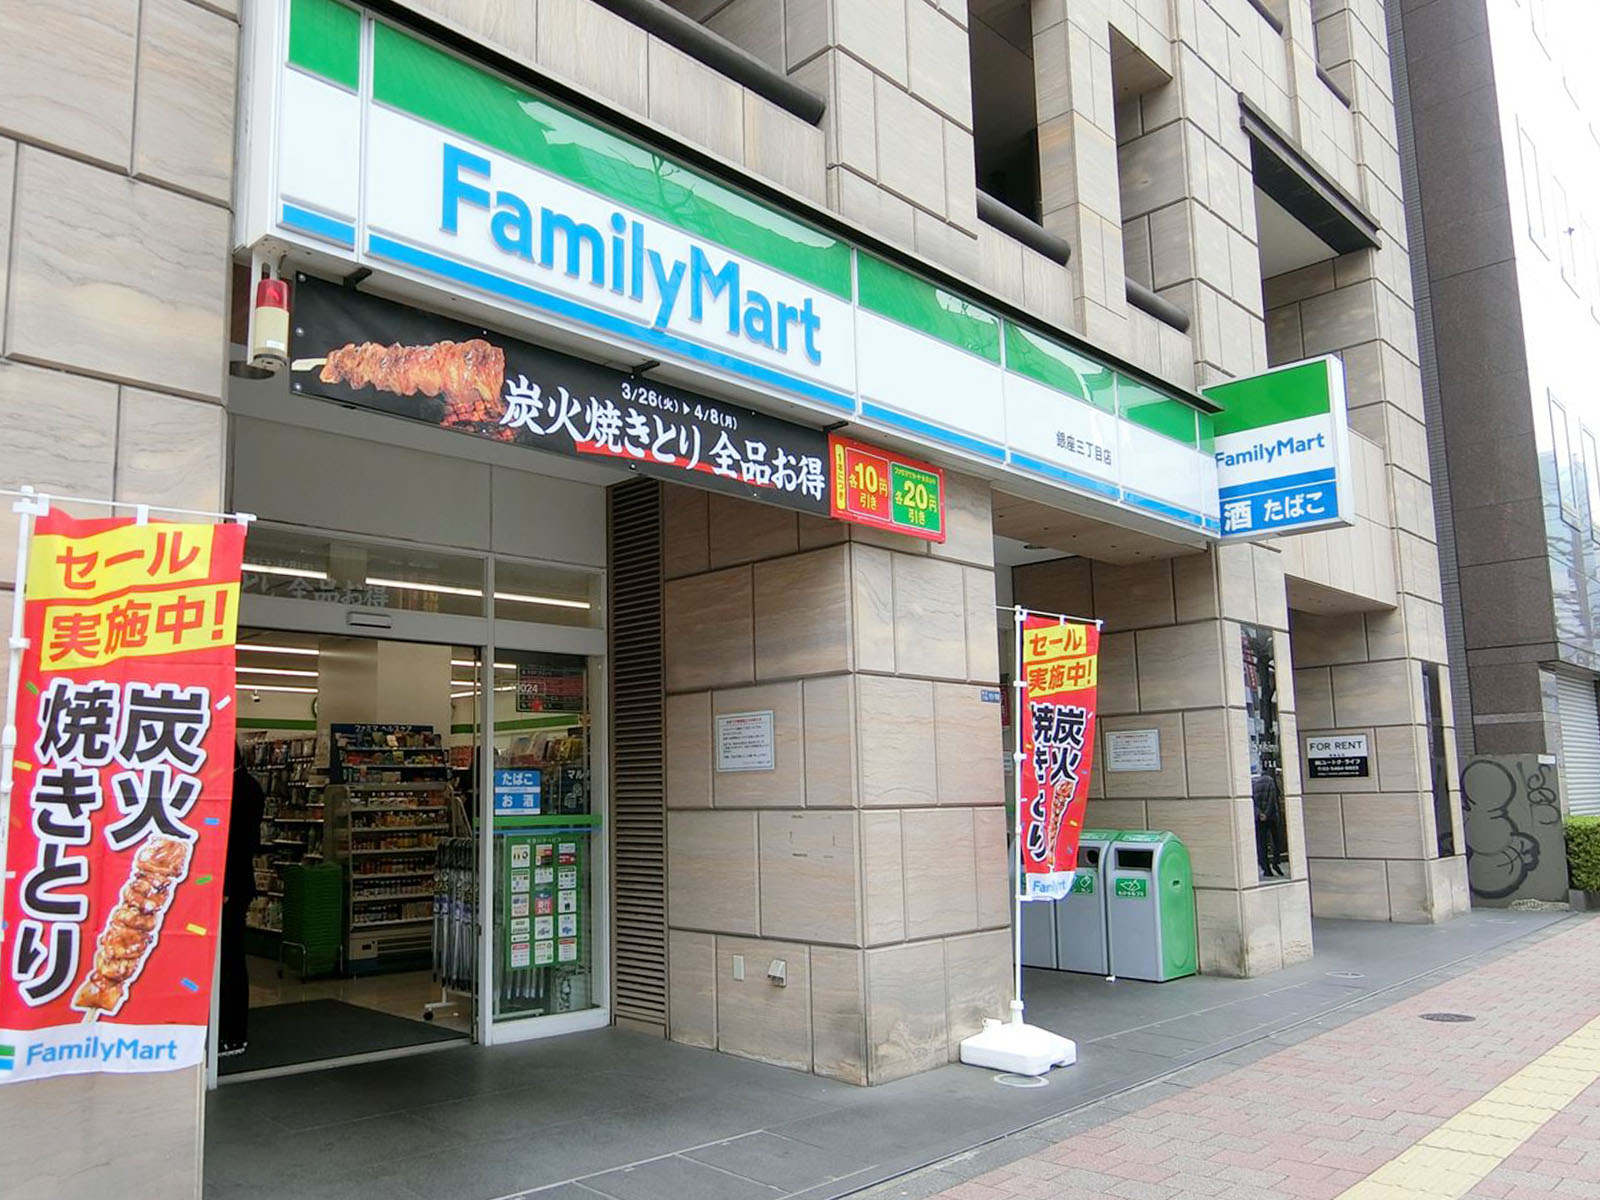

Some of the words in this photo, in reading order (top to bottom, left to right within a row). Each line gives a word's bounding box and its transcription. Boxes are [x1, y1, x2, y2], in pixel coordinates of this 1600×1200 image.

[440, 142, 822, 366] FamilyMart
[499, 374, 702, 470] 炭火焼きとり
[708, 430, 826, 502] 全品お得
[1055, 429, 1113, 466] 銀座三丁目店
[1215, 431, 1326, 470] FamilyMart
[1222, 499, 1252, 532] 酒
[1263, 490, 1326, 523] たばこ
[56, 530, 200, 591] セール
[49, 590, 229, 663] 実施中!
[1029, 627, 1083, 656] セール
[1028, 659, 1093, 693] 実施中!
[1051, 707, 1084, 783] 炭火
[1309, 742, 1331, 751] FOR
[1335, 740, 1363, 750] RENT
[110, 688, 207, 845] 炭火
[502, 772, 534, 786] たばこ
[18, 683, 115, 1000] 焼きとり
[26, 1035, 178, 1066] FamilyMart
